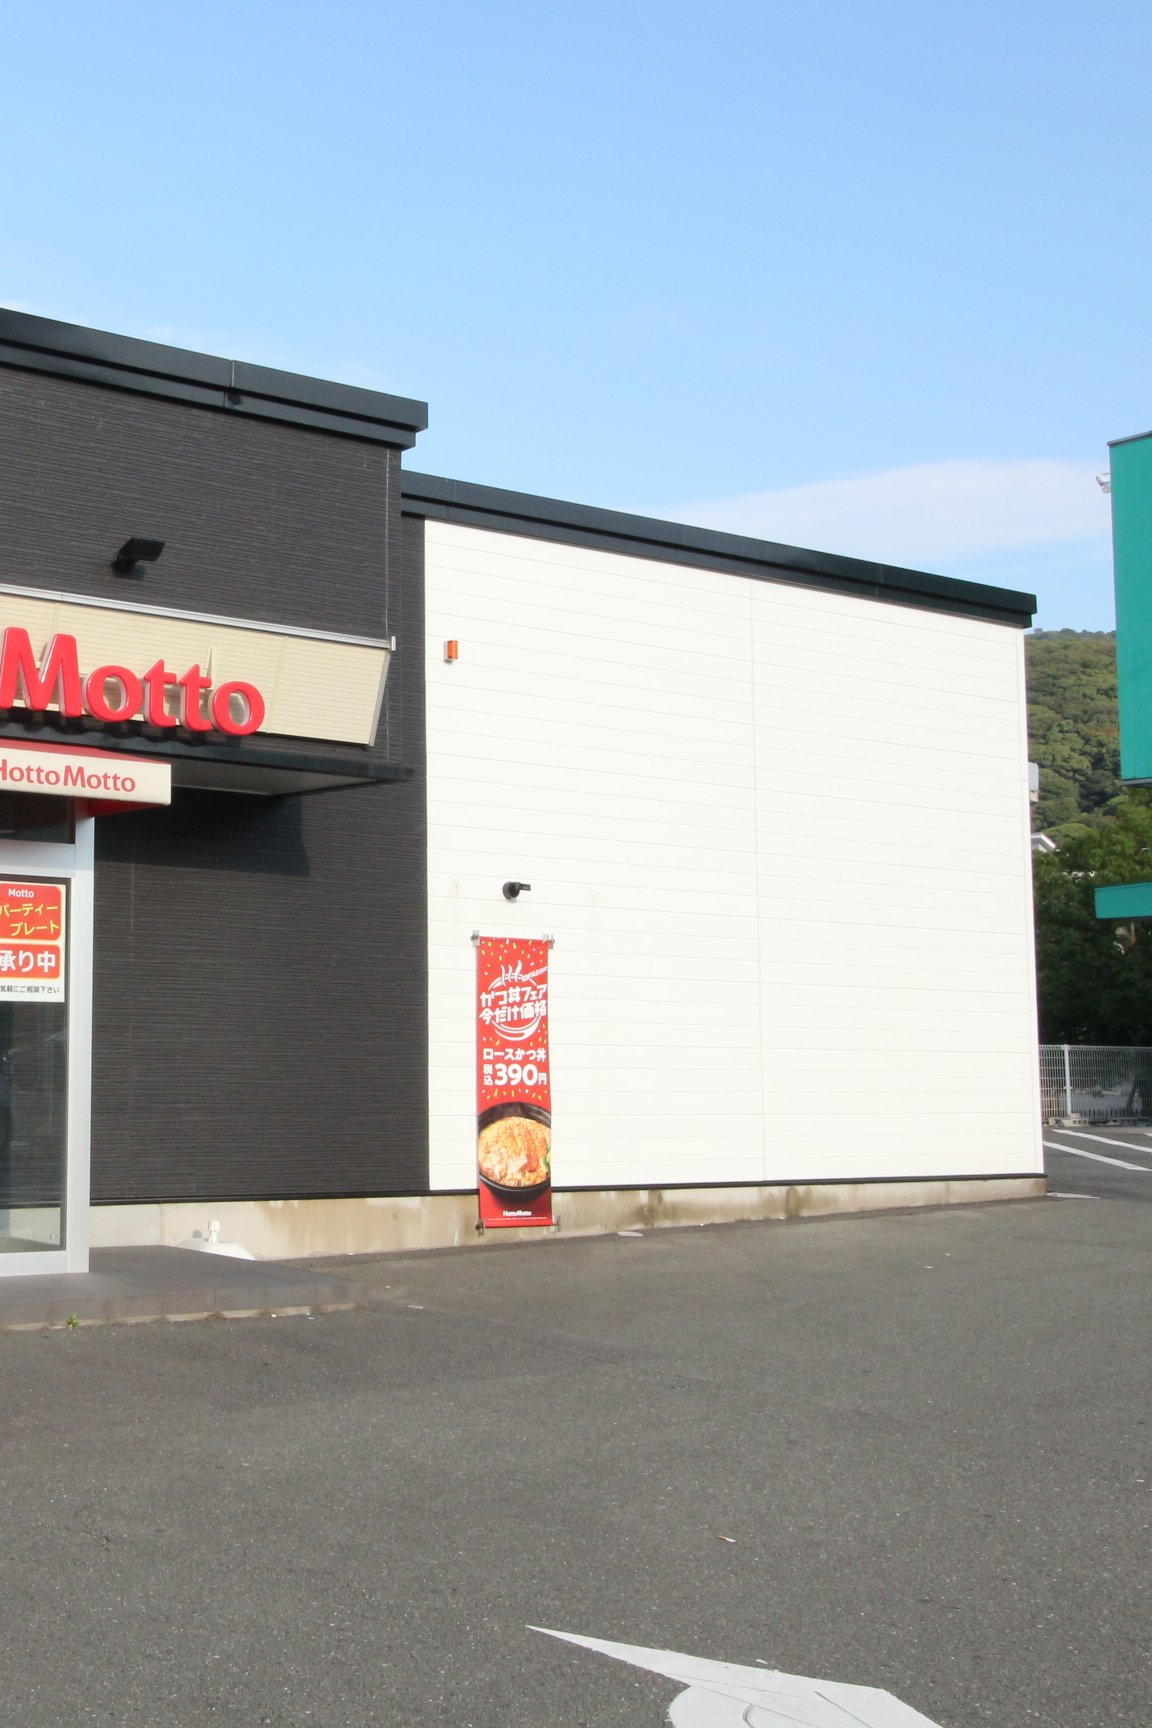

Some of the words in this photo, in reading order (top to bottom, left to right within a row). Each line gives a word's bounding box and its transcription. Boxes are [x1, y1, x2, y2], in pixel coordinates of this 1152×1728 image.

[8, 888, 35, 898] Motto
[478, 1000, 547, 1025] 今だけ価格
[482, 1047, 547, 1062] ロースかつ丼
